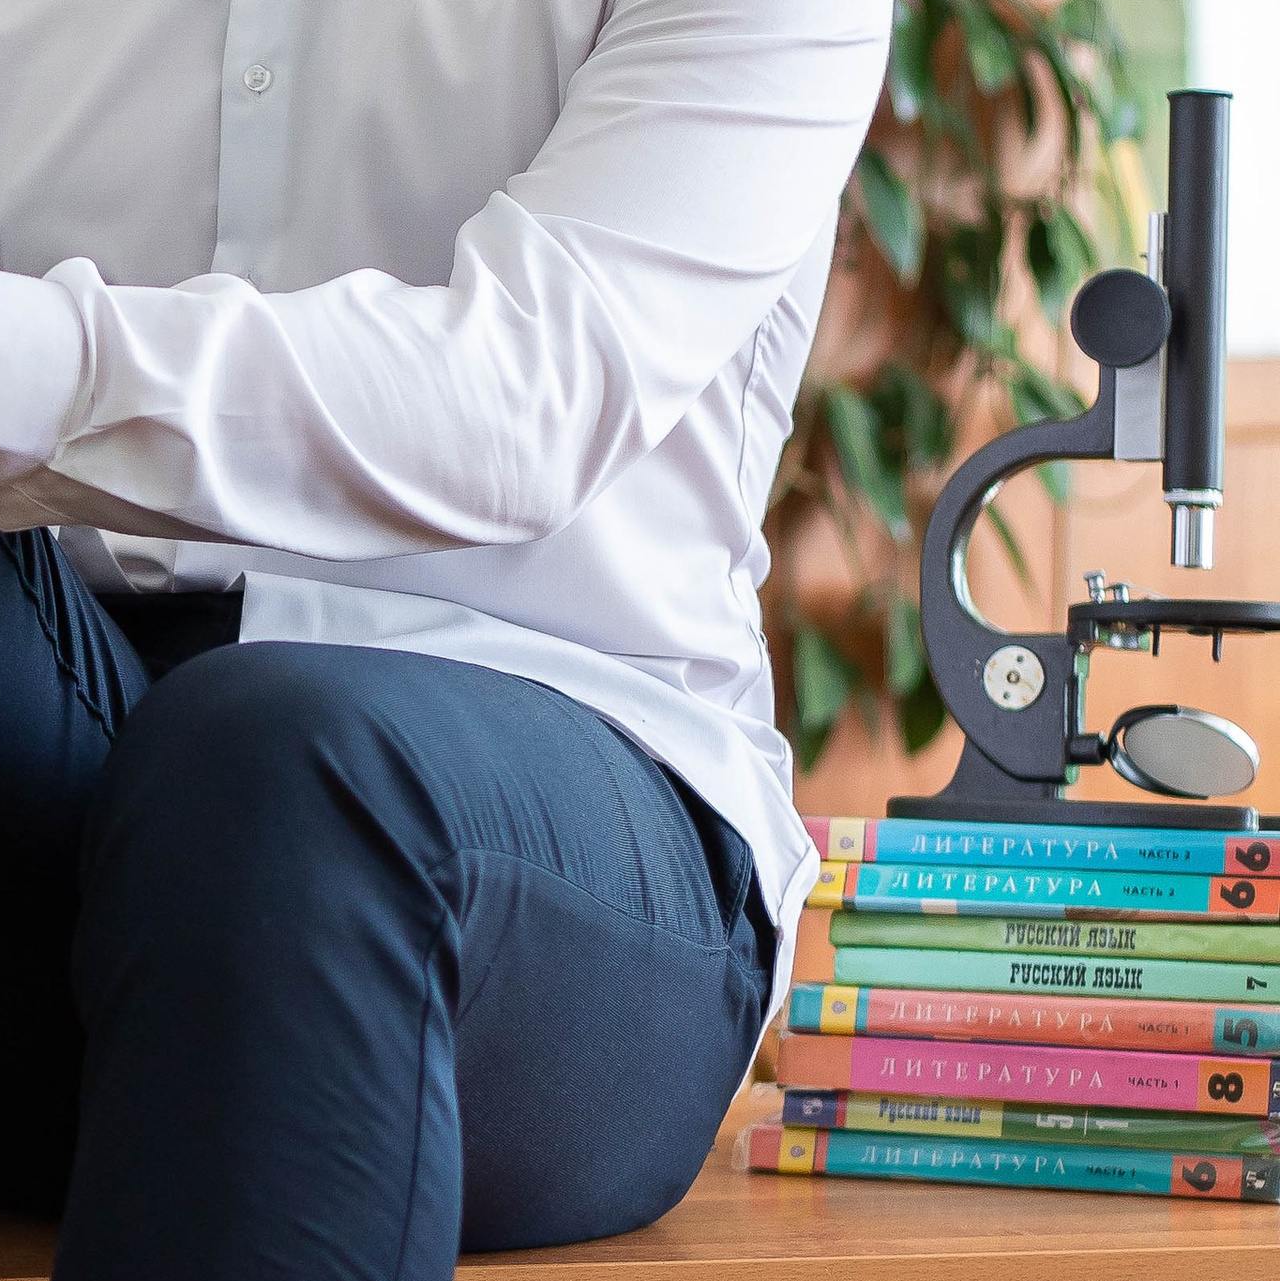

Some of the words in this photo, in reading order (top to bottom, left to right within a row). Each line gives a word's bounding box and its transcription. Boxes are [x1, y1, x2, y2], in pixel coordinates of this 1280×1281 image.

[910, 834, 1118, 861] ЛИТЕРАТУРА
[1138, 848, 1179, 860] ЧАСТЬ
[1235, 841, 1271, 872] 6
[892, 872, 1102, 897] ЛИТЕРАТУРА
[1122, 885, 1163, 897] ЧАСТЬ
[1220, 881, 1256, 909] 6
[1004, 922, 1081, 948] РУССКИЙ
[1086, 927, 1137, 950] ЯЗЫК
[1010, 962, 1087, 988] РУССКИЙ
[1092, 966, 1143, 990] ЯЗЫК
[1246, 975, 1268, 991] 7
[890, 1001, 1114, 1033] ЛИТЕРАТУРА
[1138, 1022, 1178, 1034] ЧАСТЬ
[1185, 1025, 1190, 1035] 1
[1223, 1018, 1259, 1048] 5
[880, 1057, 1103, 1089] ЛИТЕРАТУРА
[1127, 1076, 1168, 1089] ЧАСТЬ
[1174, 1079, 1179, 1089] 1
[1207, 1072, 1244, 1103] 8
[878, 1096, 940, 1123] Русский
[945, 1104, 982, 1124] язык
[860, 1145, 1066, 1175] ЛИТЕРАТУРА
[1086, 1165, 1126, 1178] ЧАСТЬ
[1131, 1168, 1136, 1179] 1
[1182, 1161, 1218, 1192] 6
